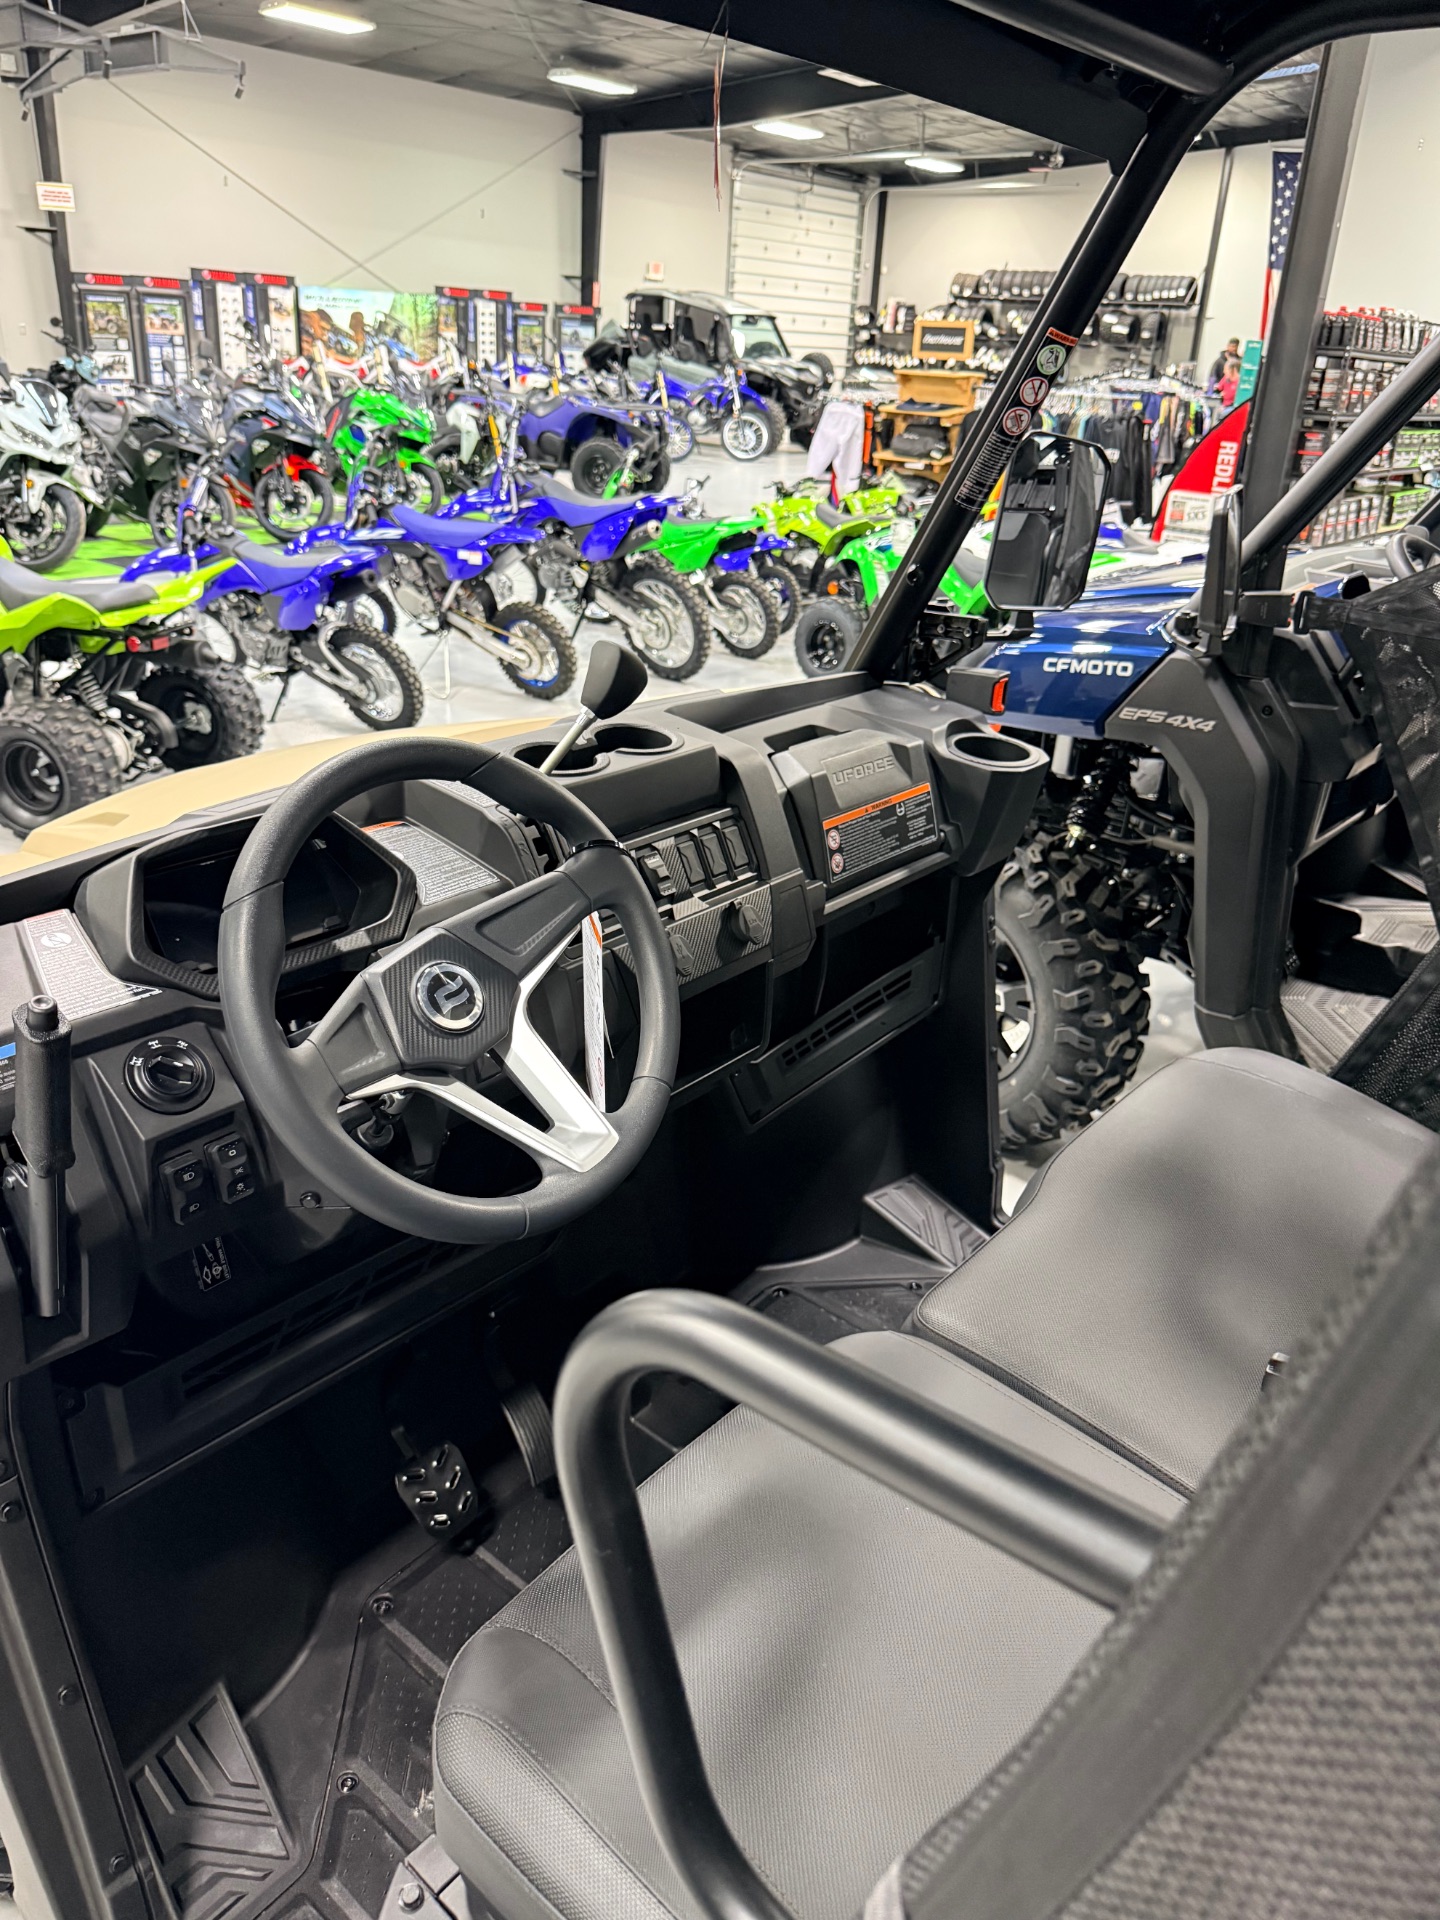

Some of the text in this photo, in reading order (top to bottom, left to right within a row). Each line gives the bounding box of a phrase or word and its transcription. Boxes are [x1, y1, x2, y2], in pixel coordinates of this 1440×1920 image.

[1043, 657, 1134, 677] CFMOTO
[1118, 706, 1168, 724] EPS
[832, 755, 895, 786] UFORCE
[871, 798, 893, 811] WARNING
